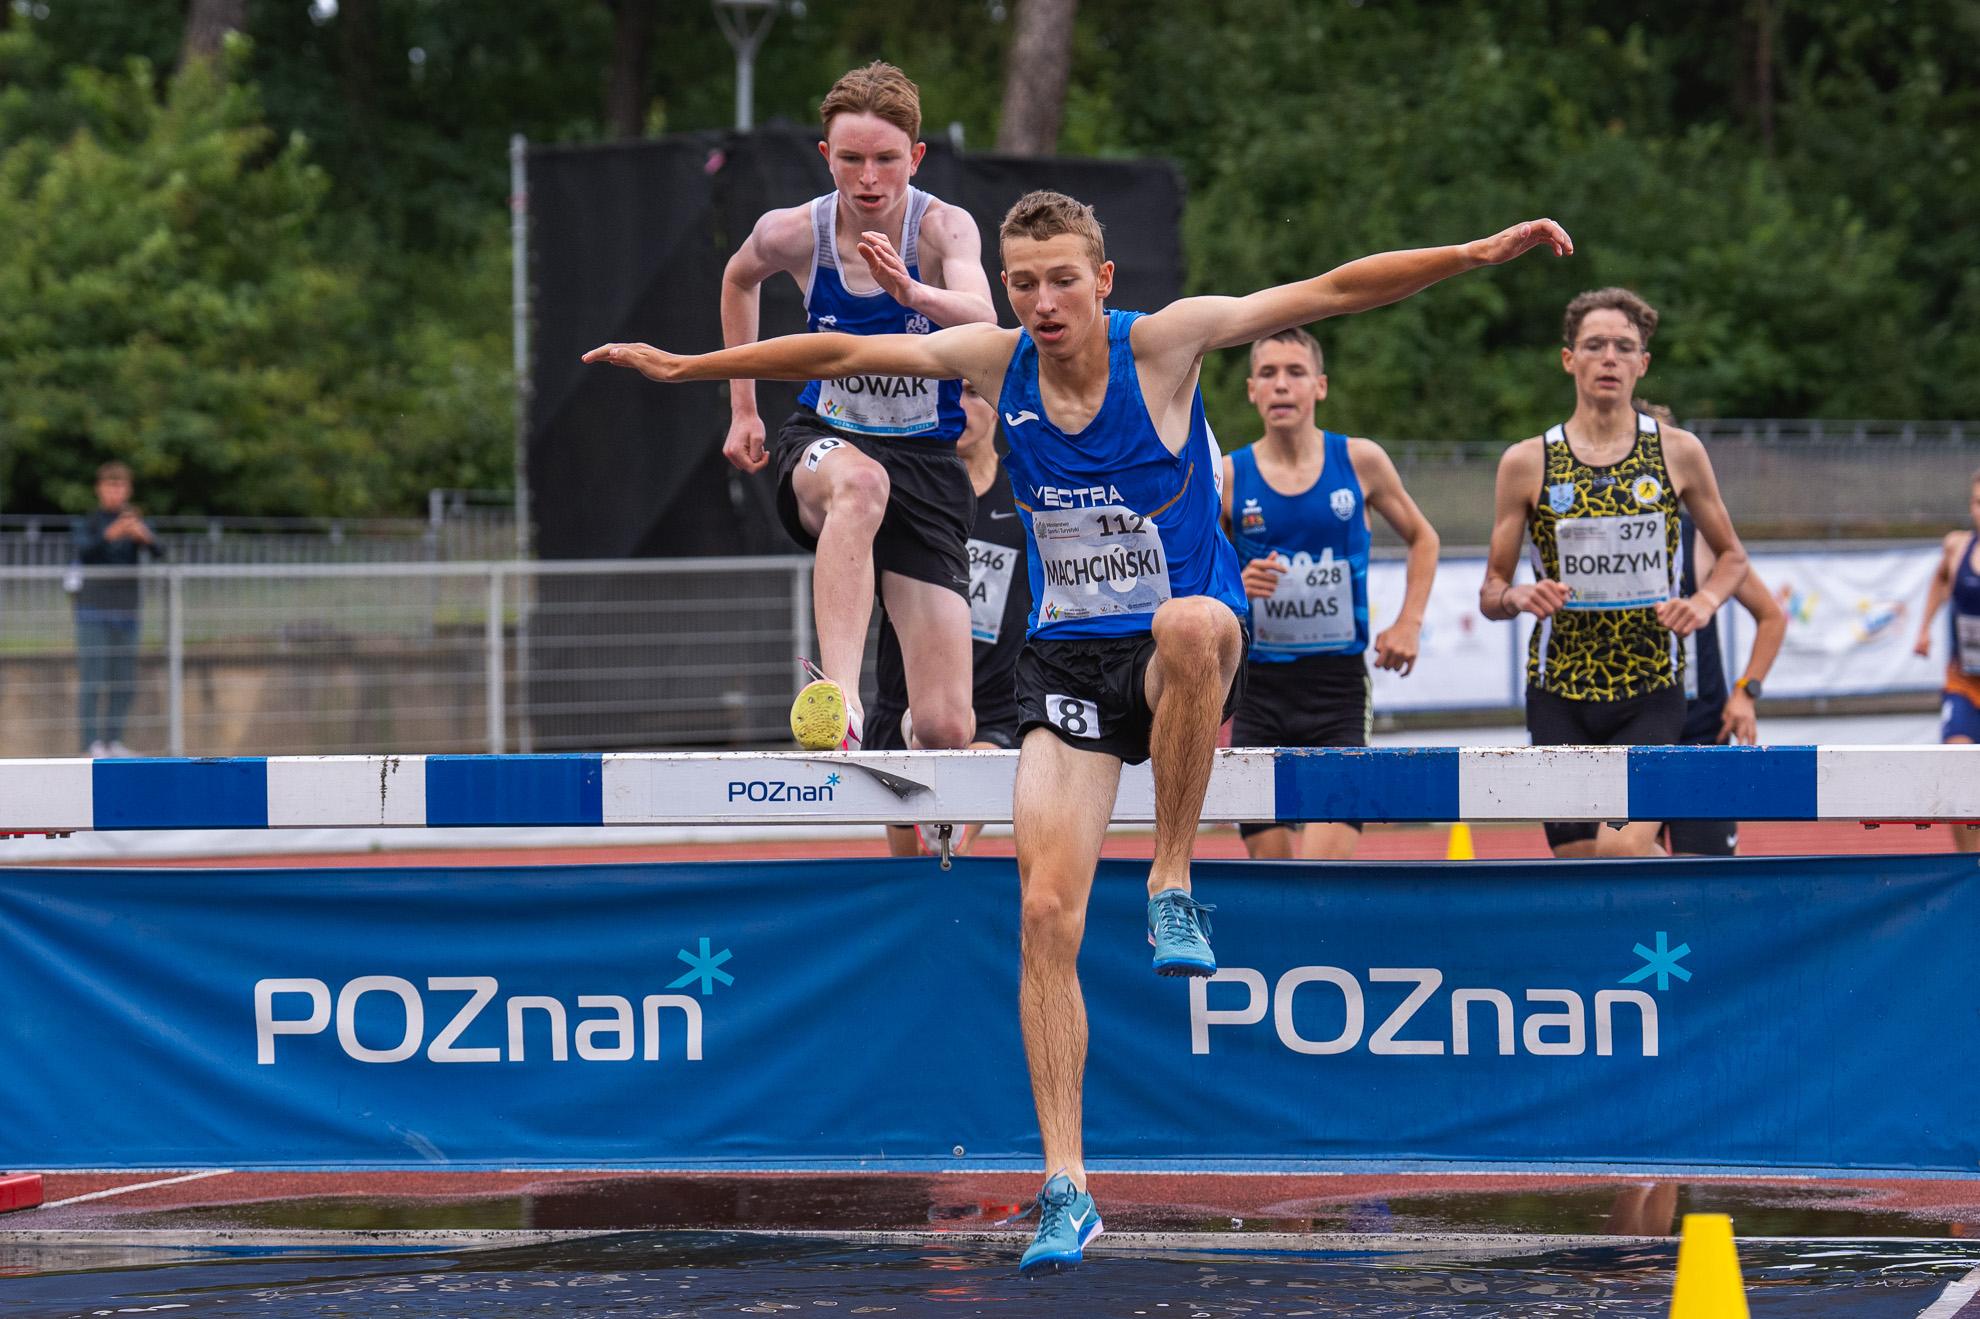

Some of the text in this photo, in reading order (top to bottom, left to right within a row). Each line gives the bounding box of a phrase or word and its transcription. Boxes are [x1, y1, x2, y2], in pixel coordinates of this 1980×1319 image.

[831, 375, 928, 398] NOWAK
[808, 439, 840, 467] 10
[1030, 485, 1124, 509] VECTRA
[1097, 513, 1147, 537] 112
[1620, 521, 1657, 540] 379
[969, 546, 1005, 570] 346
[1045, 547, 1161, 587] MACHCIŃSKI
[1564, 551, 1661, 574] BORZYM
[1306, 567, 1342, 586] 628
[1264, 597, 1339, 619] WALAS
[1058, 699, 1088, 735] 8
[728, 781, 833, 802] POZnan
[254, 975, 703, 1065] POZnan
